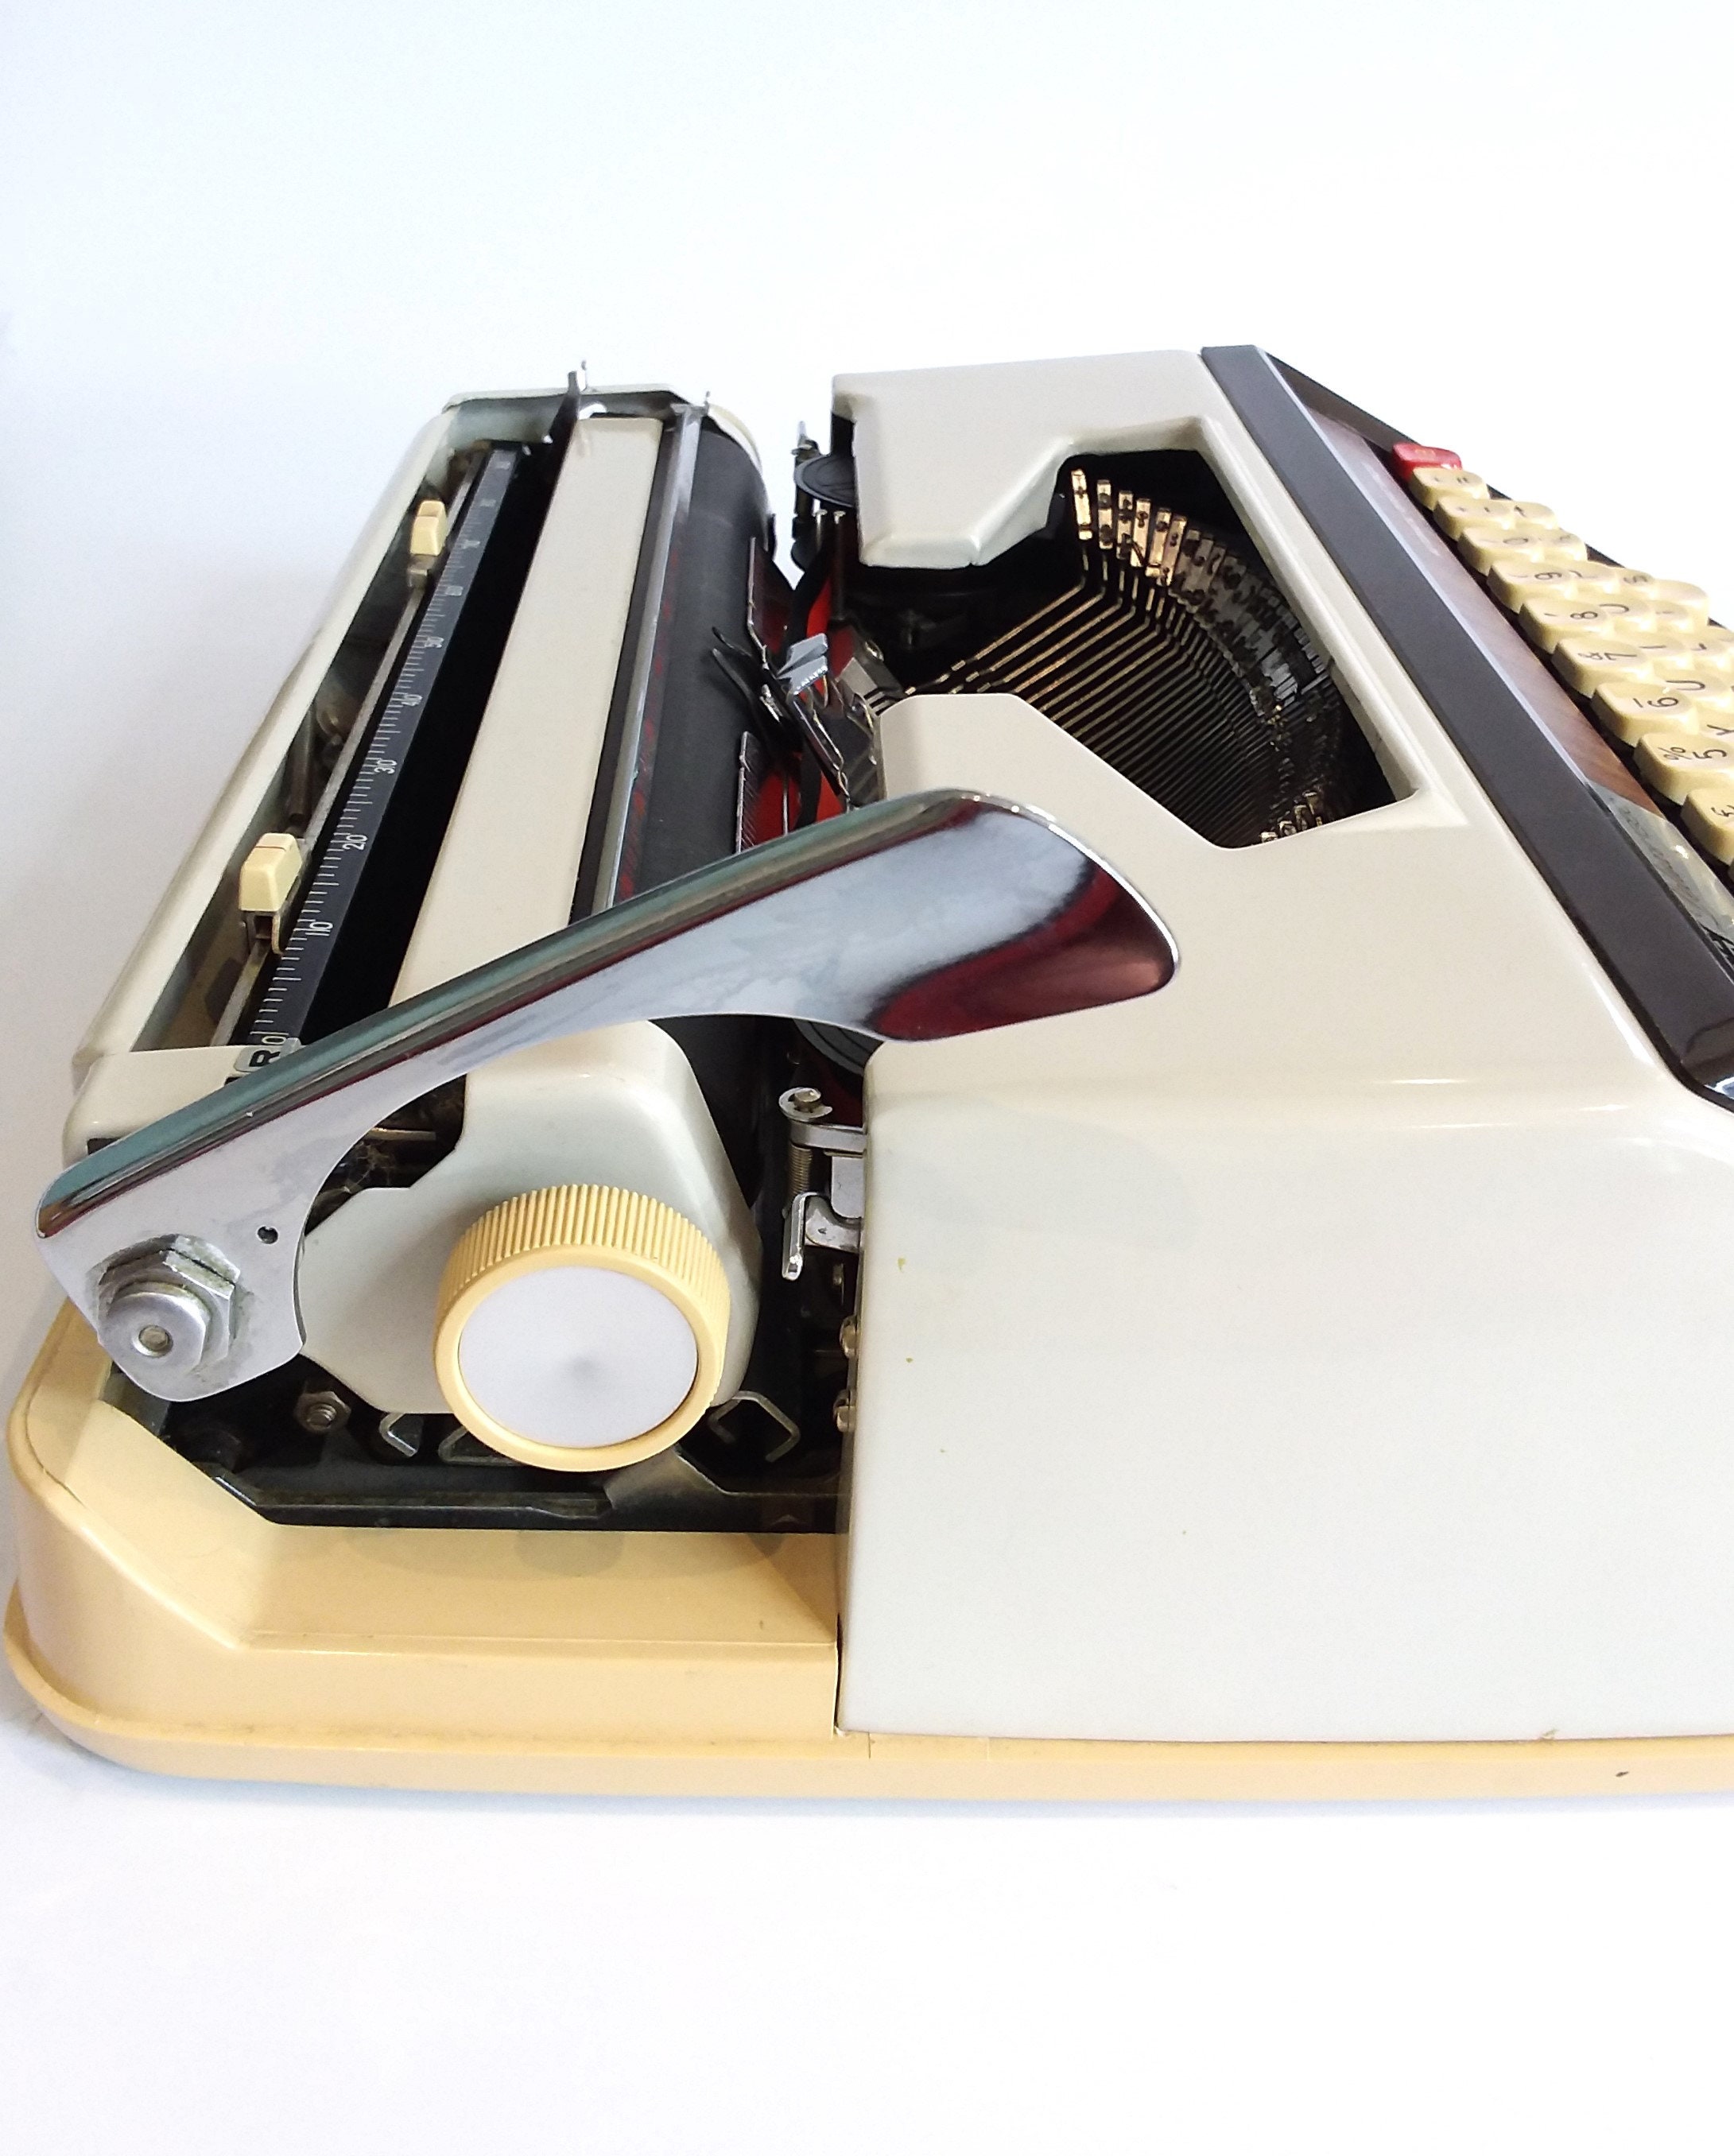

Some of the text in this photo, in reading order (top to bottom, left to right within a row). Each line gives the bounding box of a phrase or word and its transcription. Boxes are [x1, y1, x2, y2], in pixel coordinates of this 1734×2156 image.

[1647, 696, 1679, 708] 6
[1693, 749, 1728, 759] 5
[374, 759, 398, 774] 30
[343, 834, 368, 851] 20
[305, 921, 334, 936] 10
